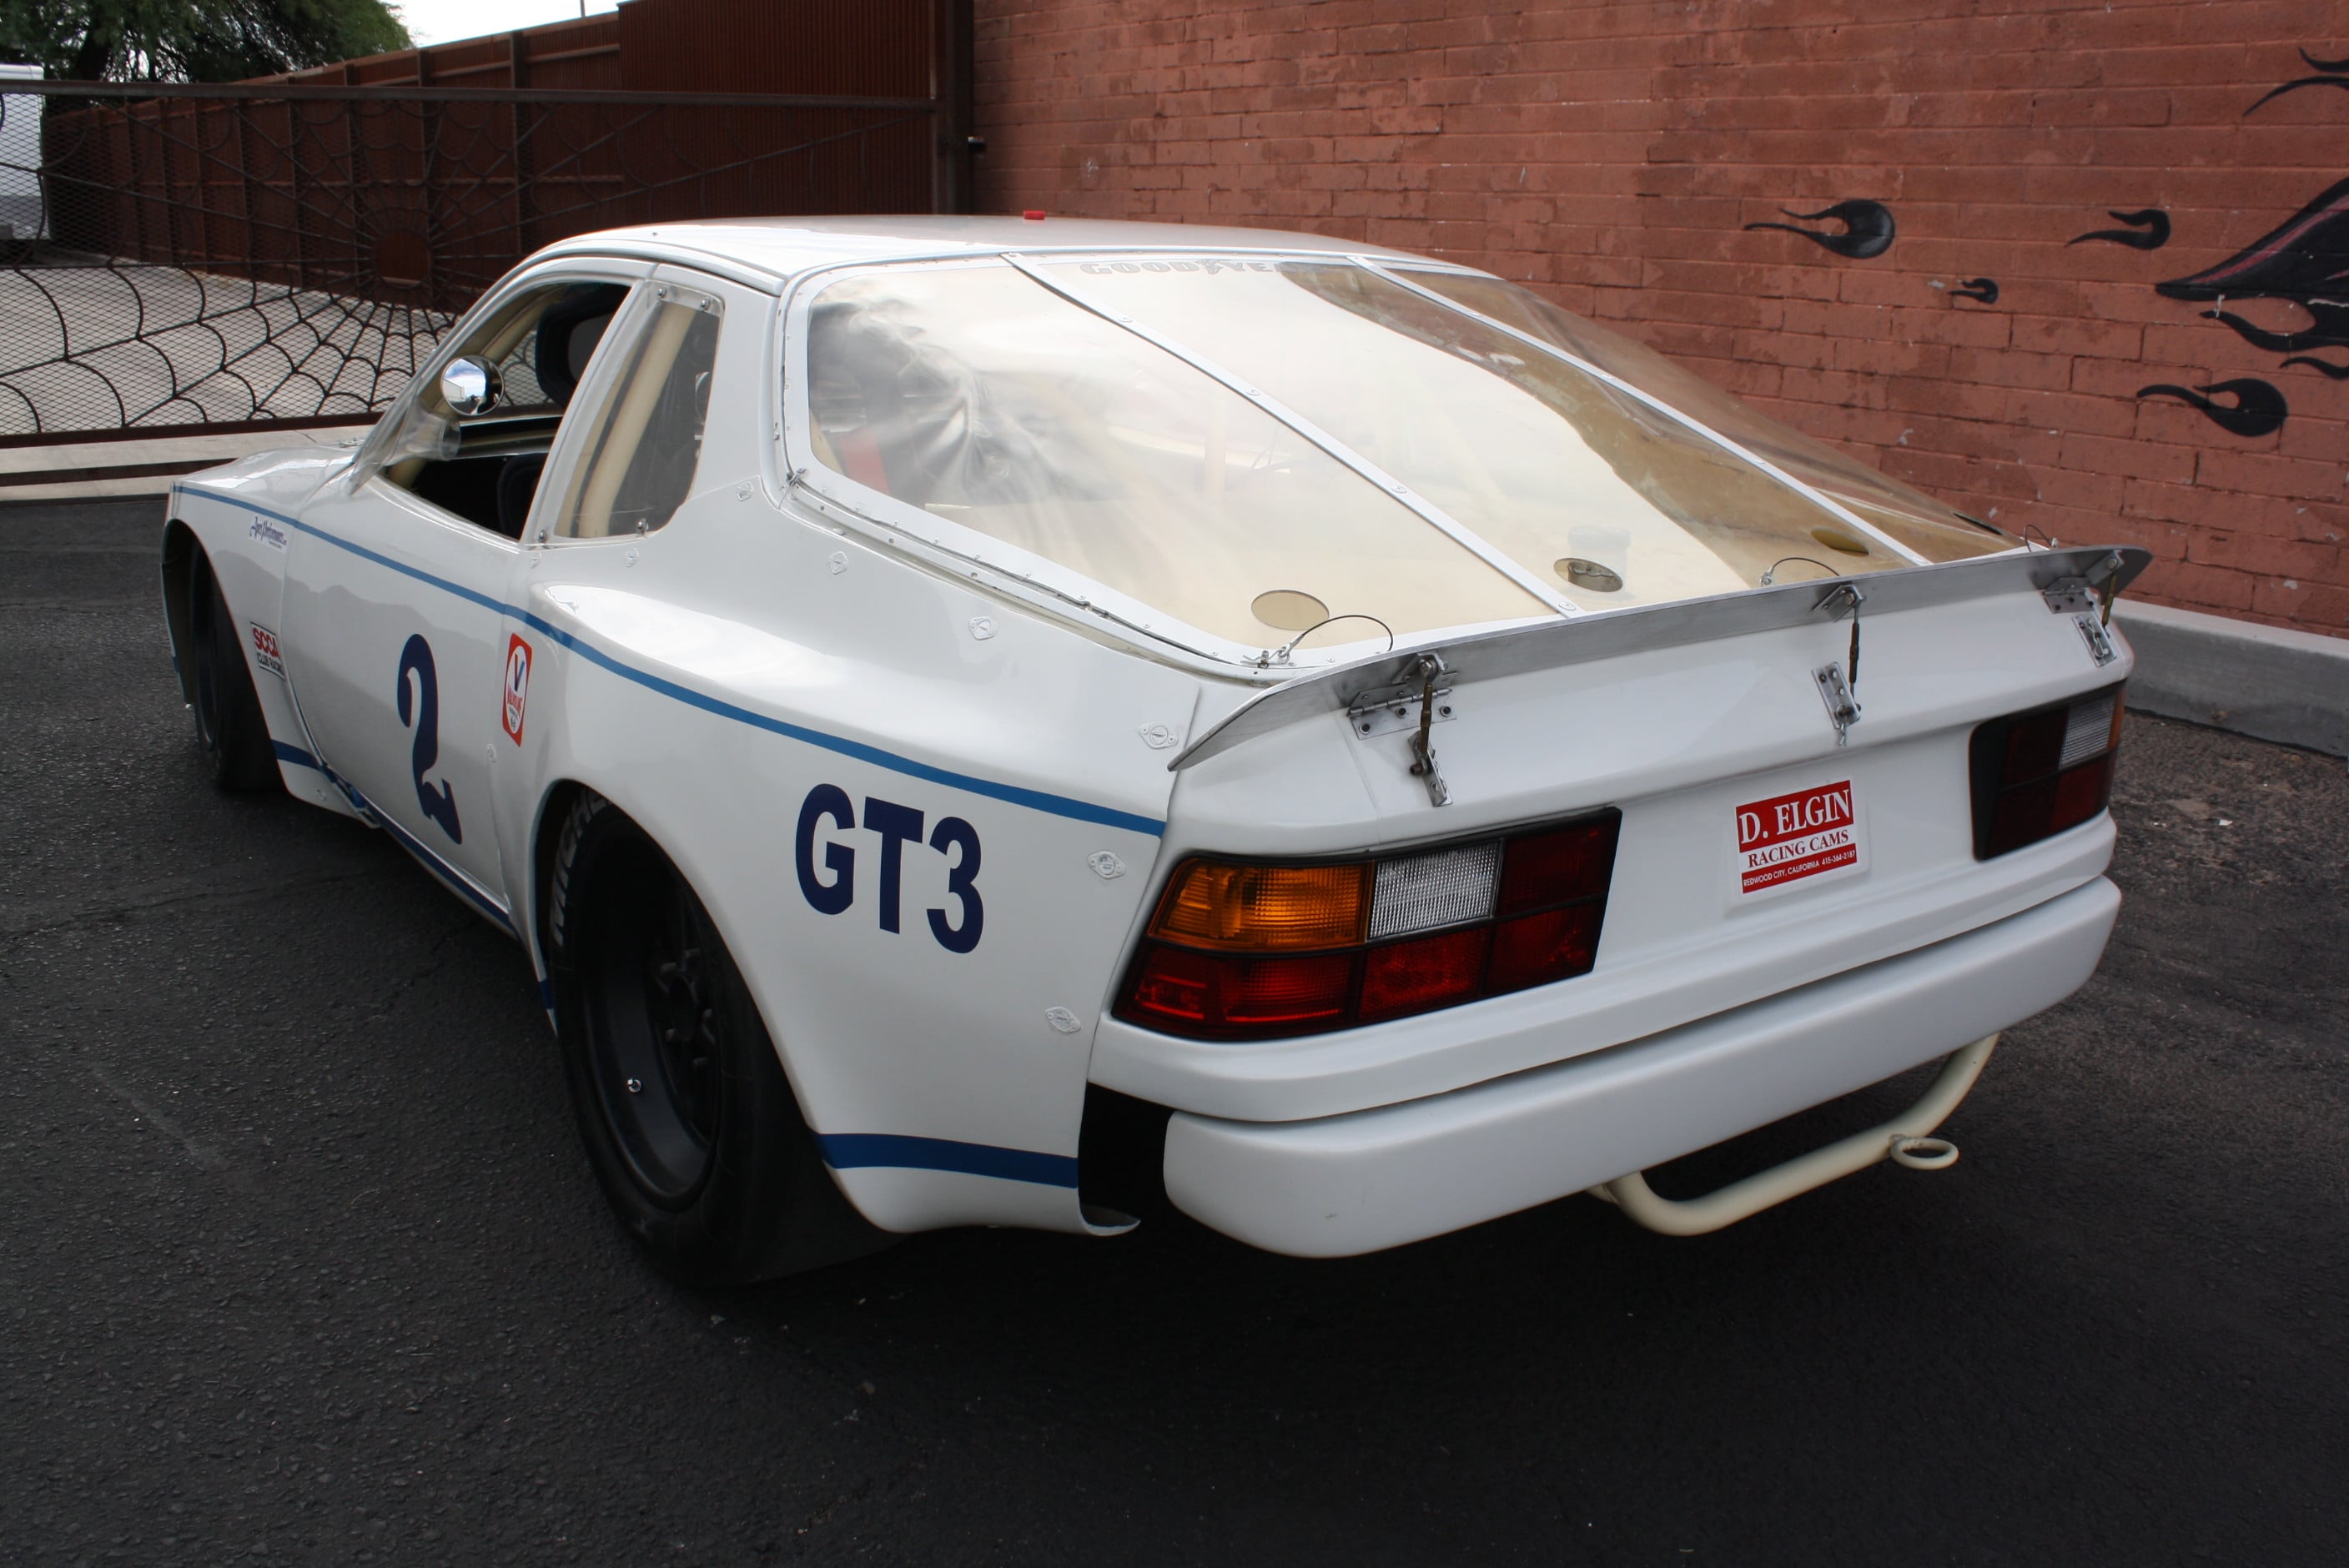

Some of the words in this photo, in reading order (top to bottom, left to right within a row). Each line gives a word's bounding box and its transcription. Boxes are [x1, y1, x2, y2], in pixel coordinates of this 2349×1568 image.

[253, 626, 279, 657] SCCA
[397, 634, 463, 846] 2
[1738, 812, 1769, 844] D.
[1774, 789, 1850, 835] ELGIN
[795, 783, 984, 954] GT3
[1748, 841, 1805, 868] RACING
[1809, 829, 1849, 852] CAMS
[1743, 872, 1773, 887] REDWOOD
[1788, 860, 1819, 875] CALIFORNIA
